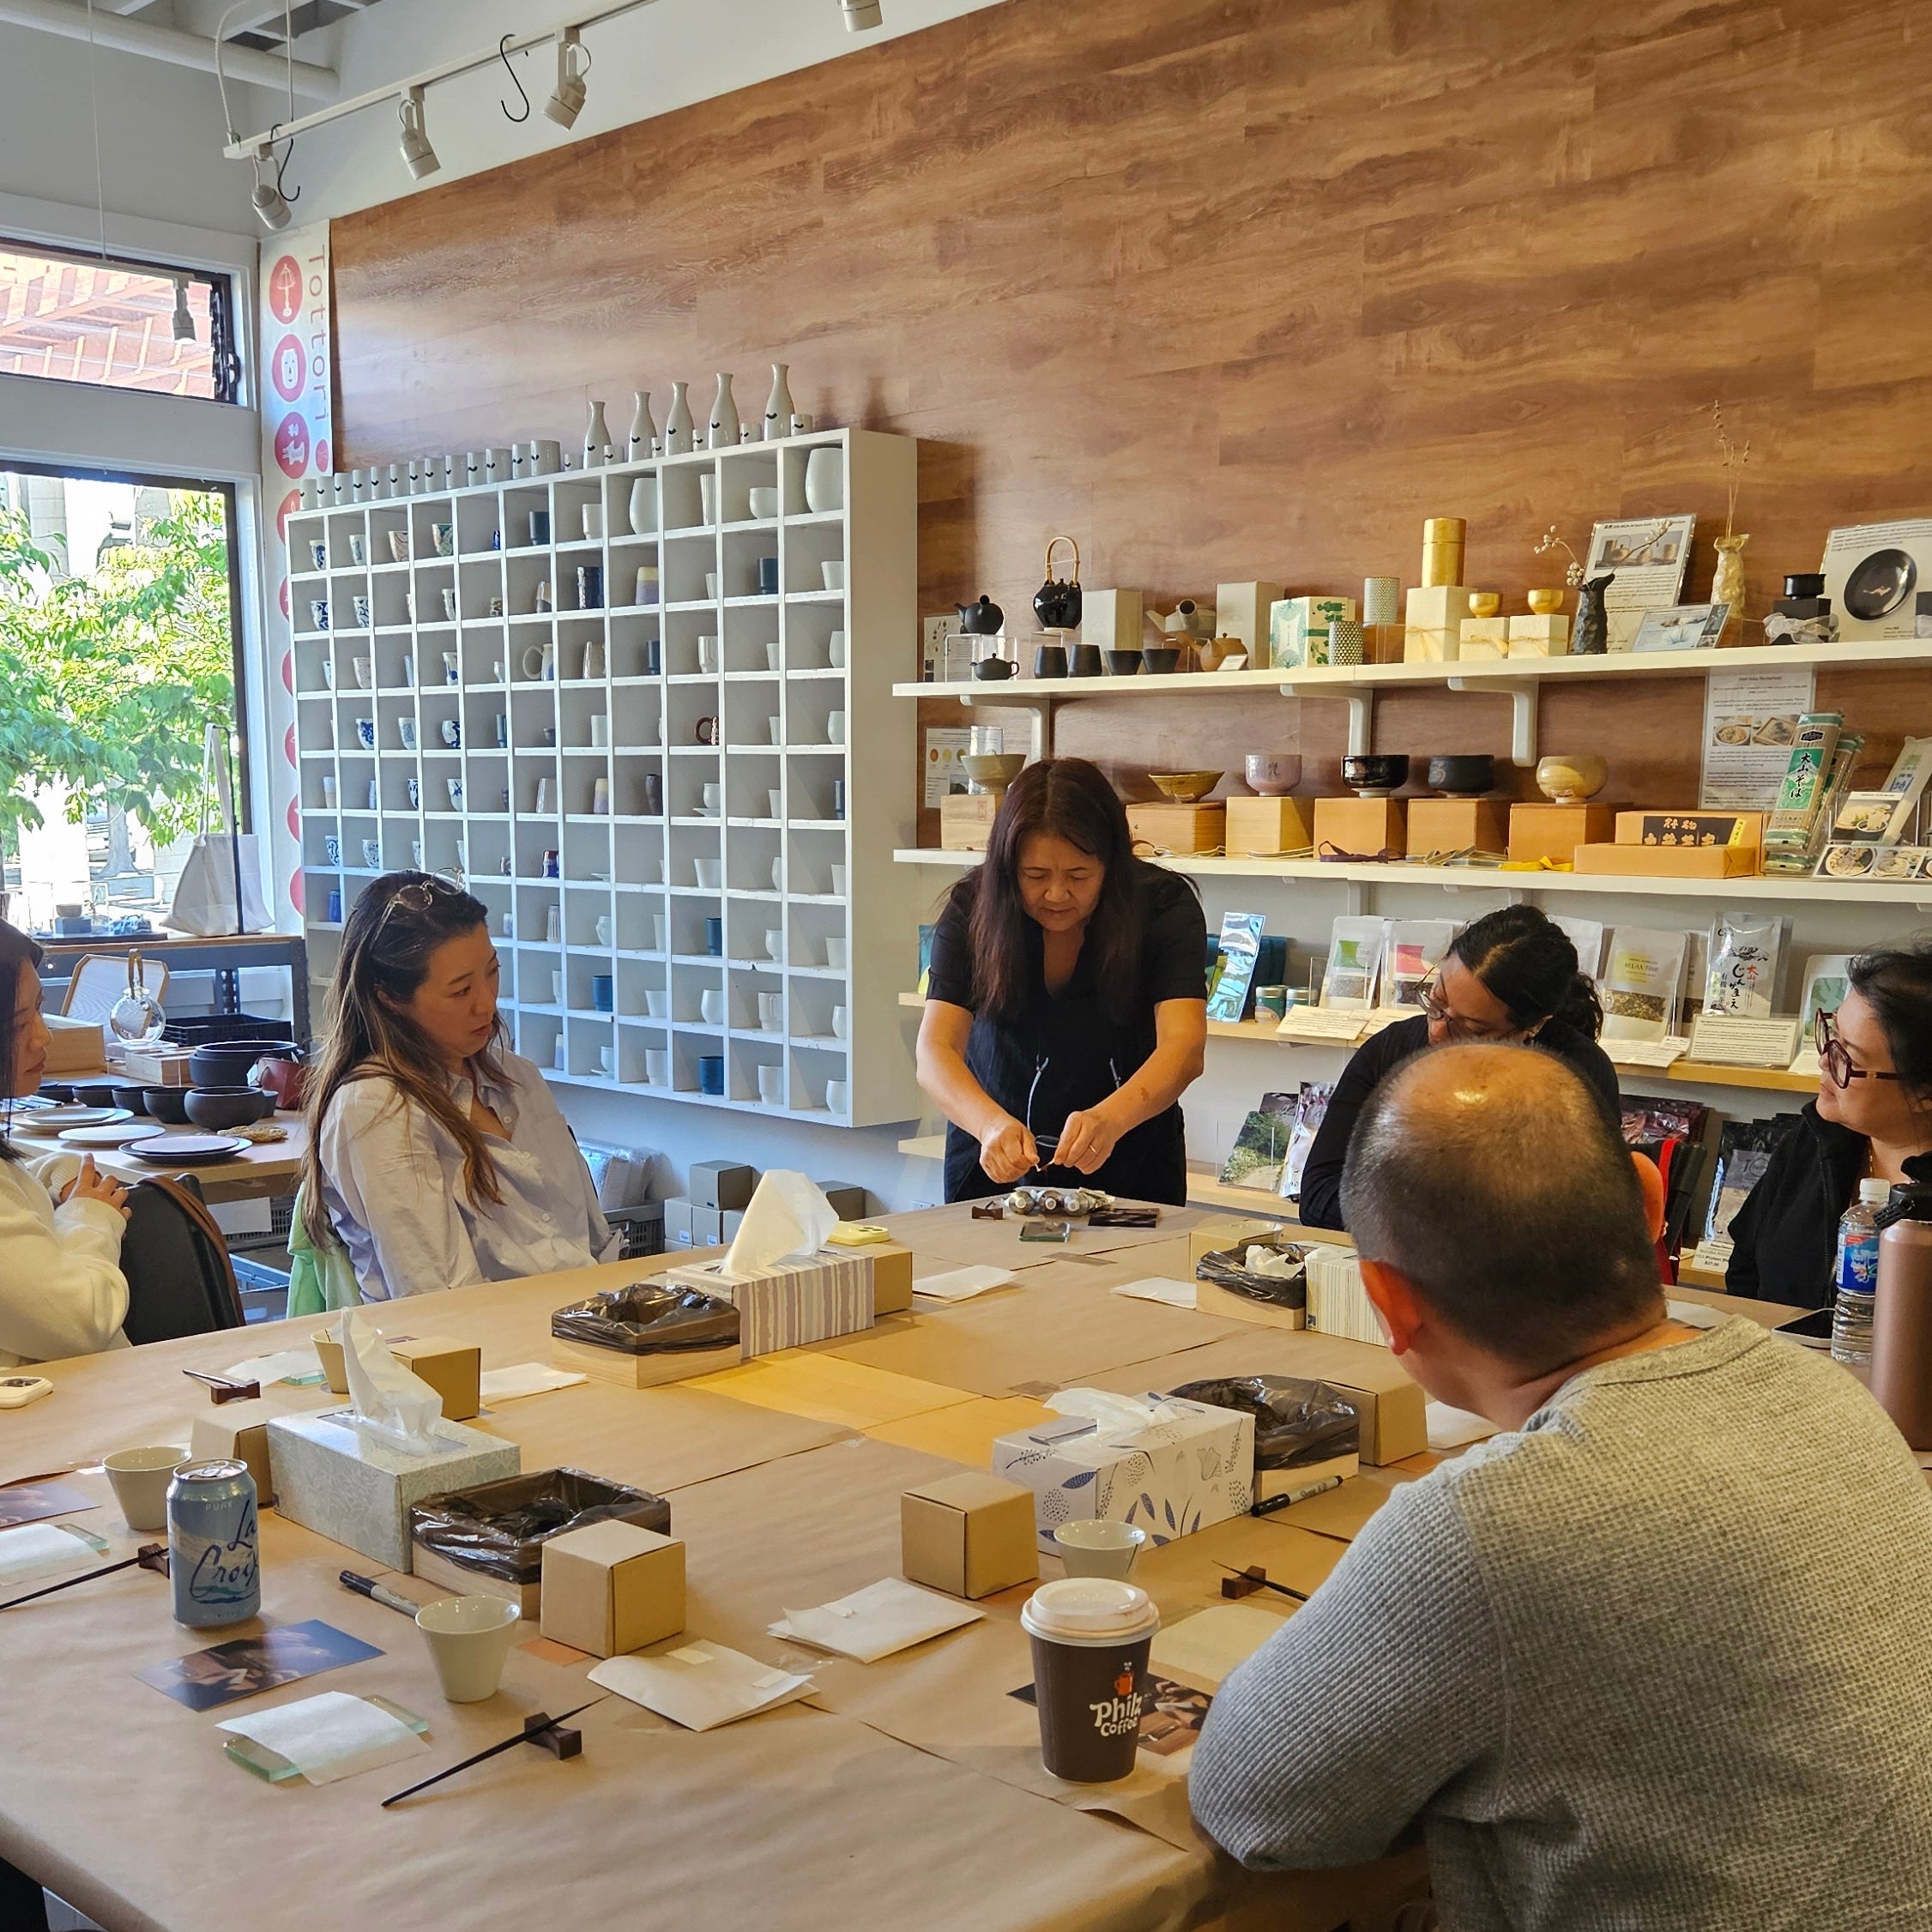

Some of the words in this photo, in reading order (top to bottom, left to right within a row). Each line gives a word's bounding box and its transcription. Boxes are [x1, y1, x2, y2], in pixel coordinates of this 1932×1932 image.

[309, 245, 329, 420] Tottori
[1790, 752, 1812, 799] 大山そば
[226, 1499, 257, 1551] La
[1089, 1692, 1143, 1728] Philz
